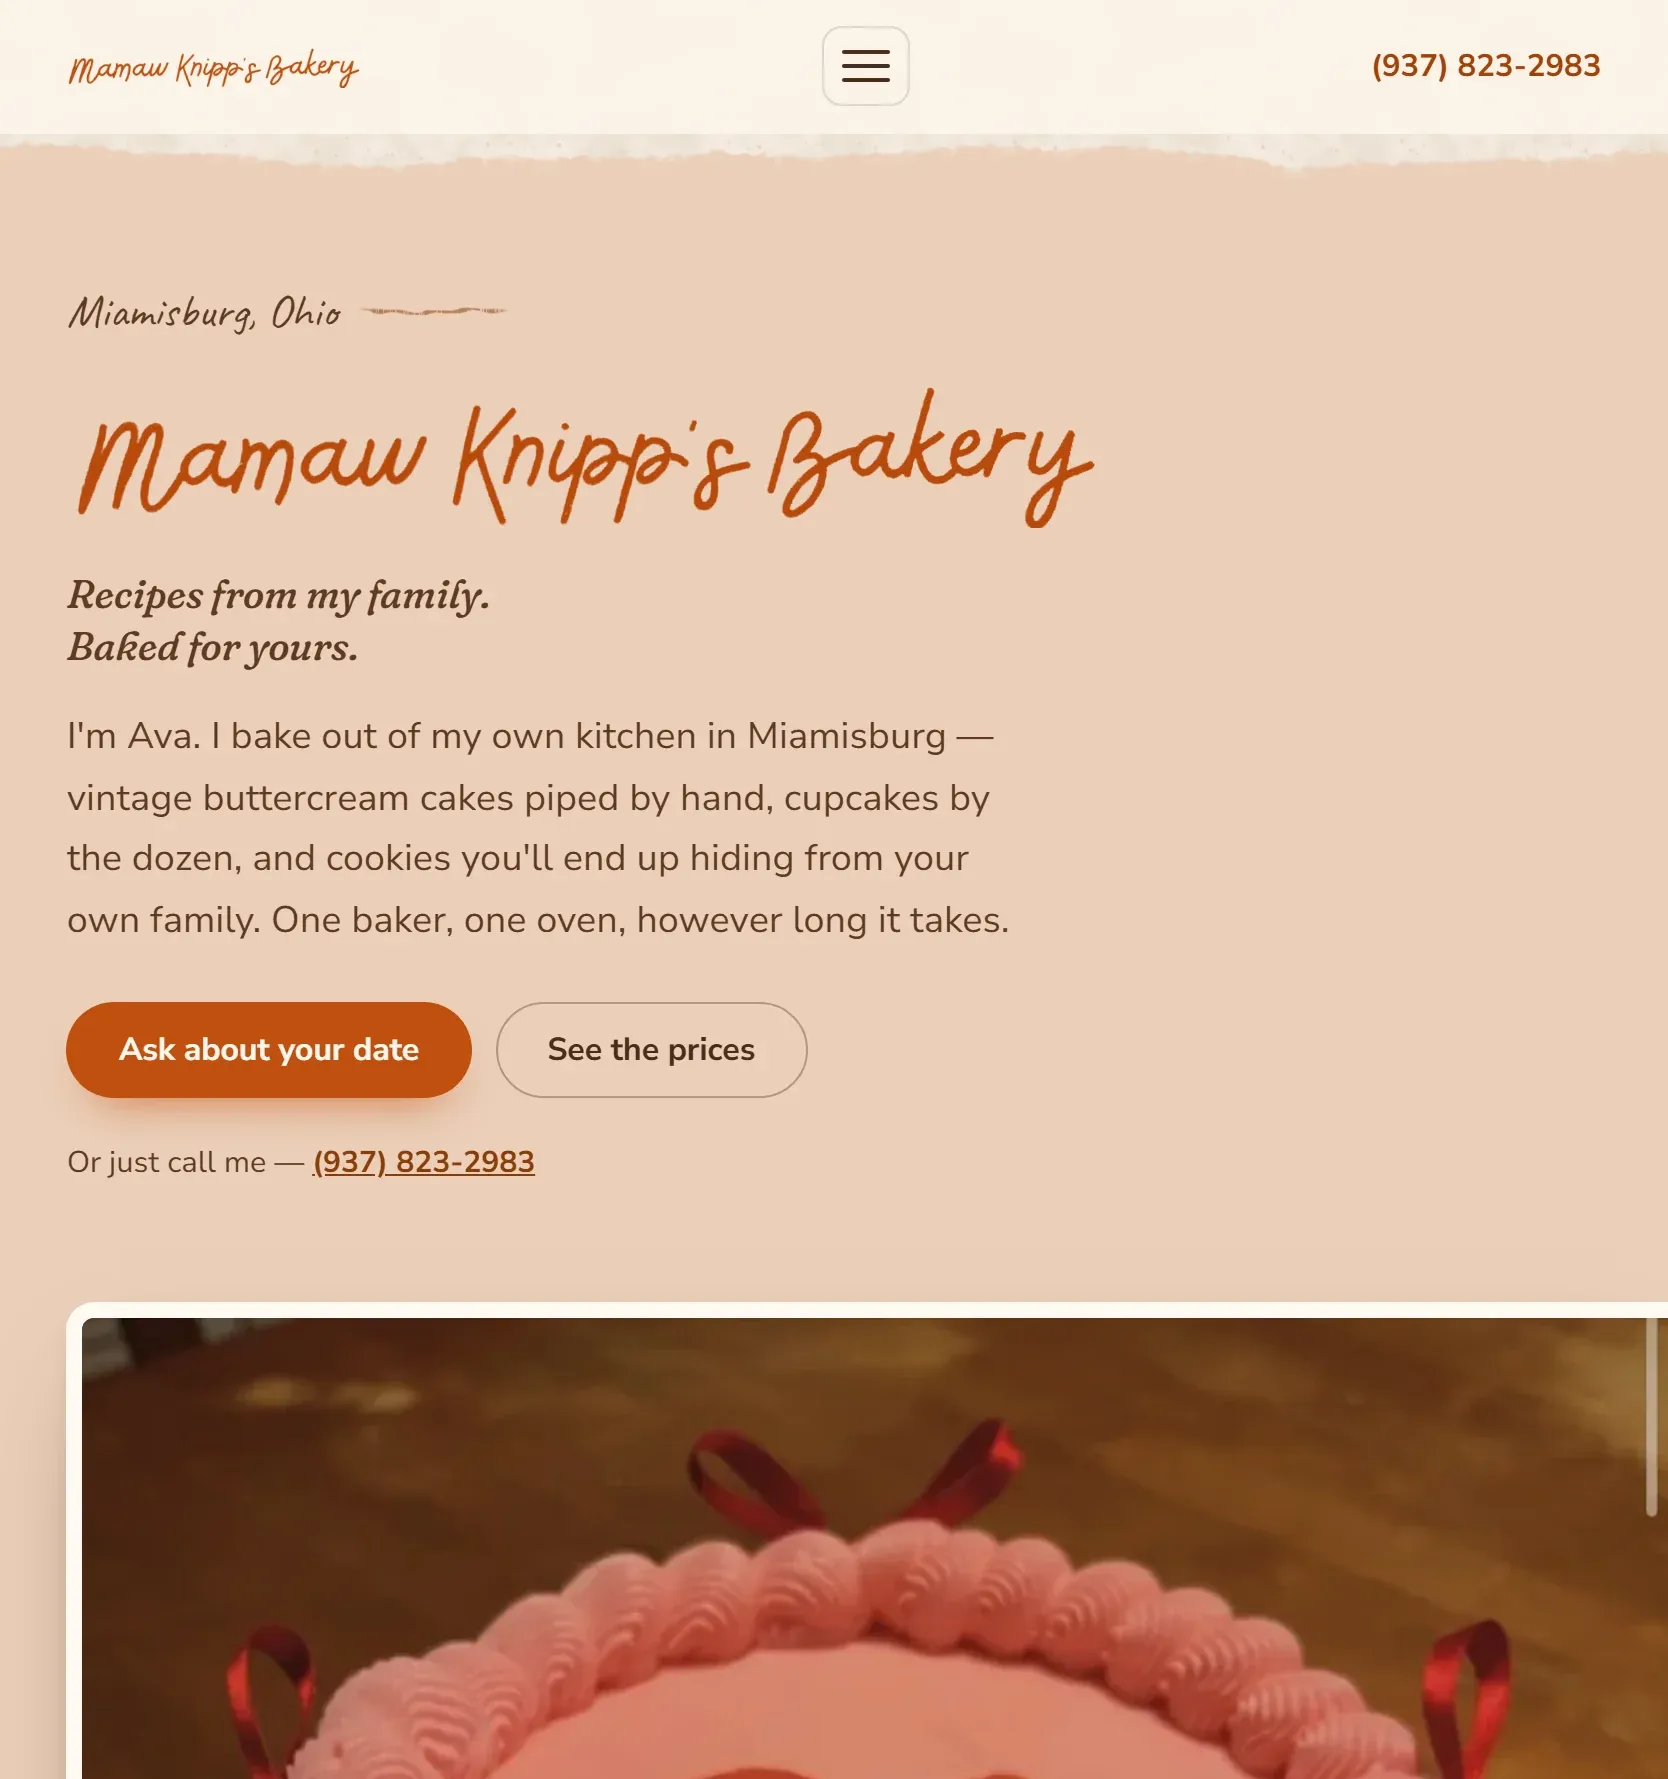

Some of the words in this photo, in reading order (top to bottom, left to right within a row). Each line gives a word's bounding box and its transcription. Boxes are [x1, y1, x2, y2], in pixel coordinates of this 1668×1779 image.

[68, 57, 170, 85] Mamaw
[175, 53, 262, 88] Knipp's
[265, 48, 360, 89] Bakery
[1373, 53, 1447, 83] (937)
[1457, 53, 1601, 78] 823-2983
[67, 294, 256, 336] Miamisburg,
[272, 294, 342, 329] Ohio
[77, 420, 428, 516] Mamaw
[451, 404, 752, 526] Knipp's
[766, 387, 1096, 529] Bakery
[66, 579, 204, 619] Recipes
[210, 578, 297, 617] from
[307, 588, 362, 619] my
[366, 578, 489, 619] family.
[66, 630, 185, 662] Baked
[187, 630, 242, 669] for
[243, 640, 358, 671] yours.
[69, 721, 115, 749] I'm
[127, 721, 200, 749] Ava.
[213, 721, 219, 749] I
[232, 721, 311, 749] bake
[322, 723, 378, 749] out
[388, 721, 422, 749] of
[432, 728, 482, 756] my
[492, 728, 564, 749] own
[577, 721, 695, 750] kitchen
[708, 721, 735, 749] in
[749, 721, 945, 756] Miamisburg
[66, 783, 192, 818] vintage
[204, 783, 408, 812] buttercream
[420, 783, 514, 812] cakes
[526, 783, 618, 818] piped
[631, 783, 671, 818] by
[682, 783, 773, 815] hand,
[785, 783, 939, 818] cupcakes
[951, 783, 991, 818] by
[67, 912, 139, 933] own
[149, 905, 260, 940] family.
[272, 904, 341, 934] One
[353, 905, 453, 937] baker,
[464, 912, 526, 934] one
[537, 912, 625, 937] oven,
[638, 905, 784, 933] however
[794, 905, 866, 940] long
[879, 905, 901, 933] it
[909, 905, 1008, 934] takes.
[118, 1036, 177, 1062] Ask
[184, 1036, 271, 1062] about
[277, 1043, 346, 1067] your
[352, 1036, 420, 1062] date
[548, 1036, 602, 1062] See
[610, 1036, 659, 1061] the
[669, 1036, 756, 1067] prices
[68, 1149, 102, 1173] Or
[106, 1150, 160, 1179] just
[168, 1150, 217, 1173] call
[225, 1156, 266, 1173] me
[314, 1149, 386, 1179] (937)
[396, 1149, 535, 1173] 823-2983
